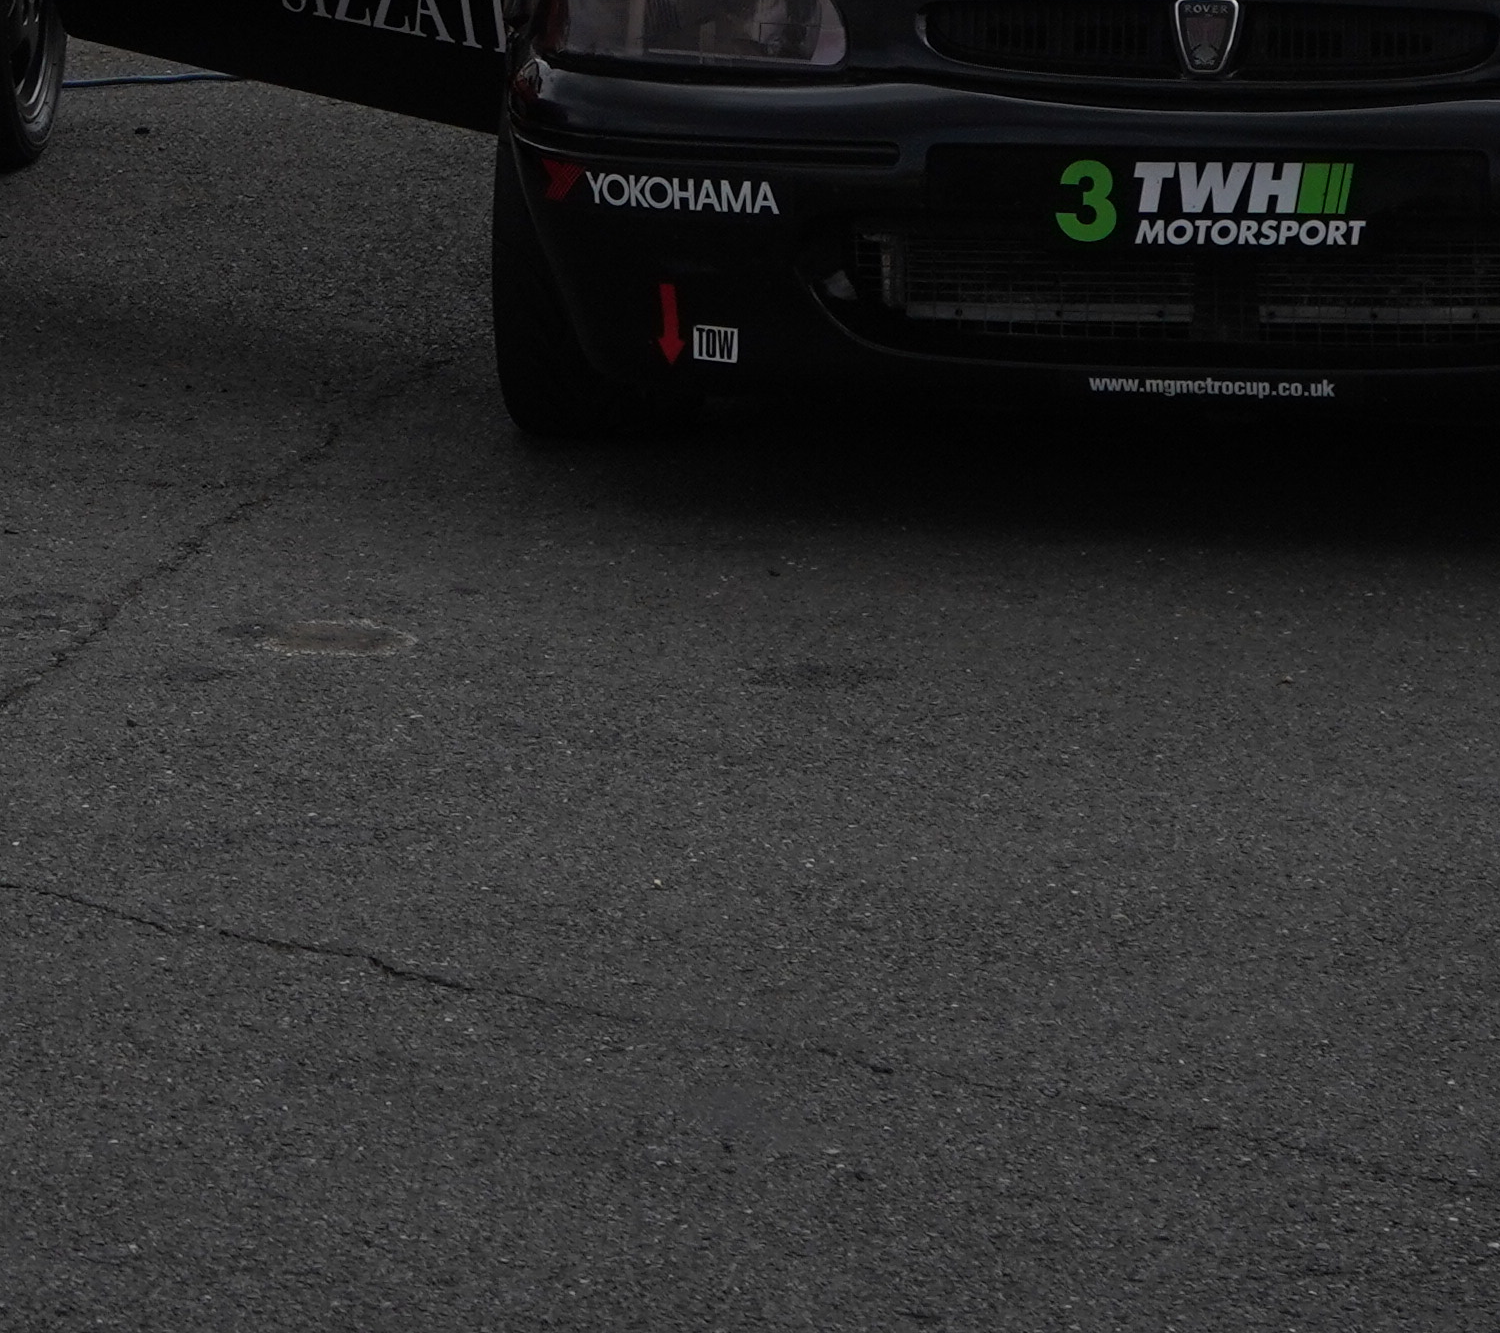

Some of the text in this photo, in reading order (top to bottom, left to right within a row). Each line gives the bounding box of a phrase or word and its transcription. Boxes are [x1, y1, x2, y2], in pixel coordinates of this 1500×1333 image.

[1184, 4, 1229, 14] ROVER
[585, 171, 780, 215] YOKOHAMA
[1055, 160, 1117, 242] 3
[1133, 161, 1304, 215] TWH
[1134, 219, 1366, 246] MOTORSPORT
[696, 327, 735, 361] TOW
[1088, 376, 1336, 399] www.mgmetrocup.co.uk
